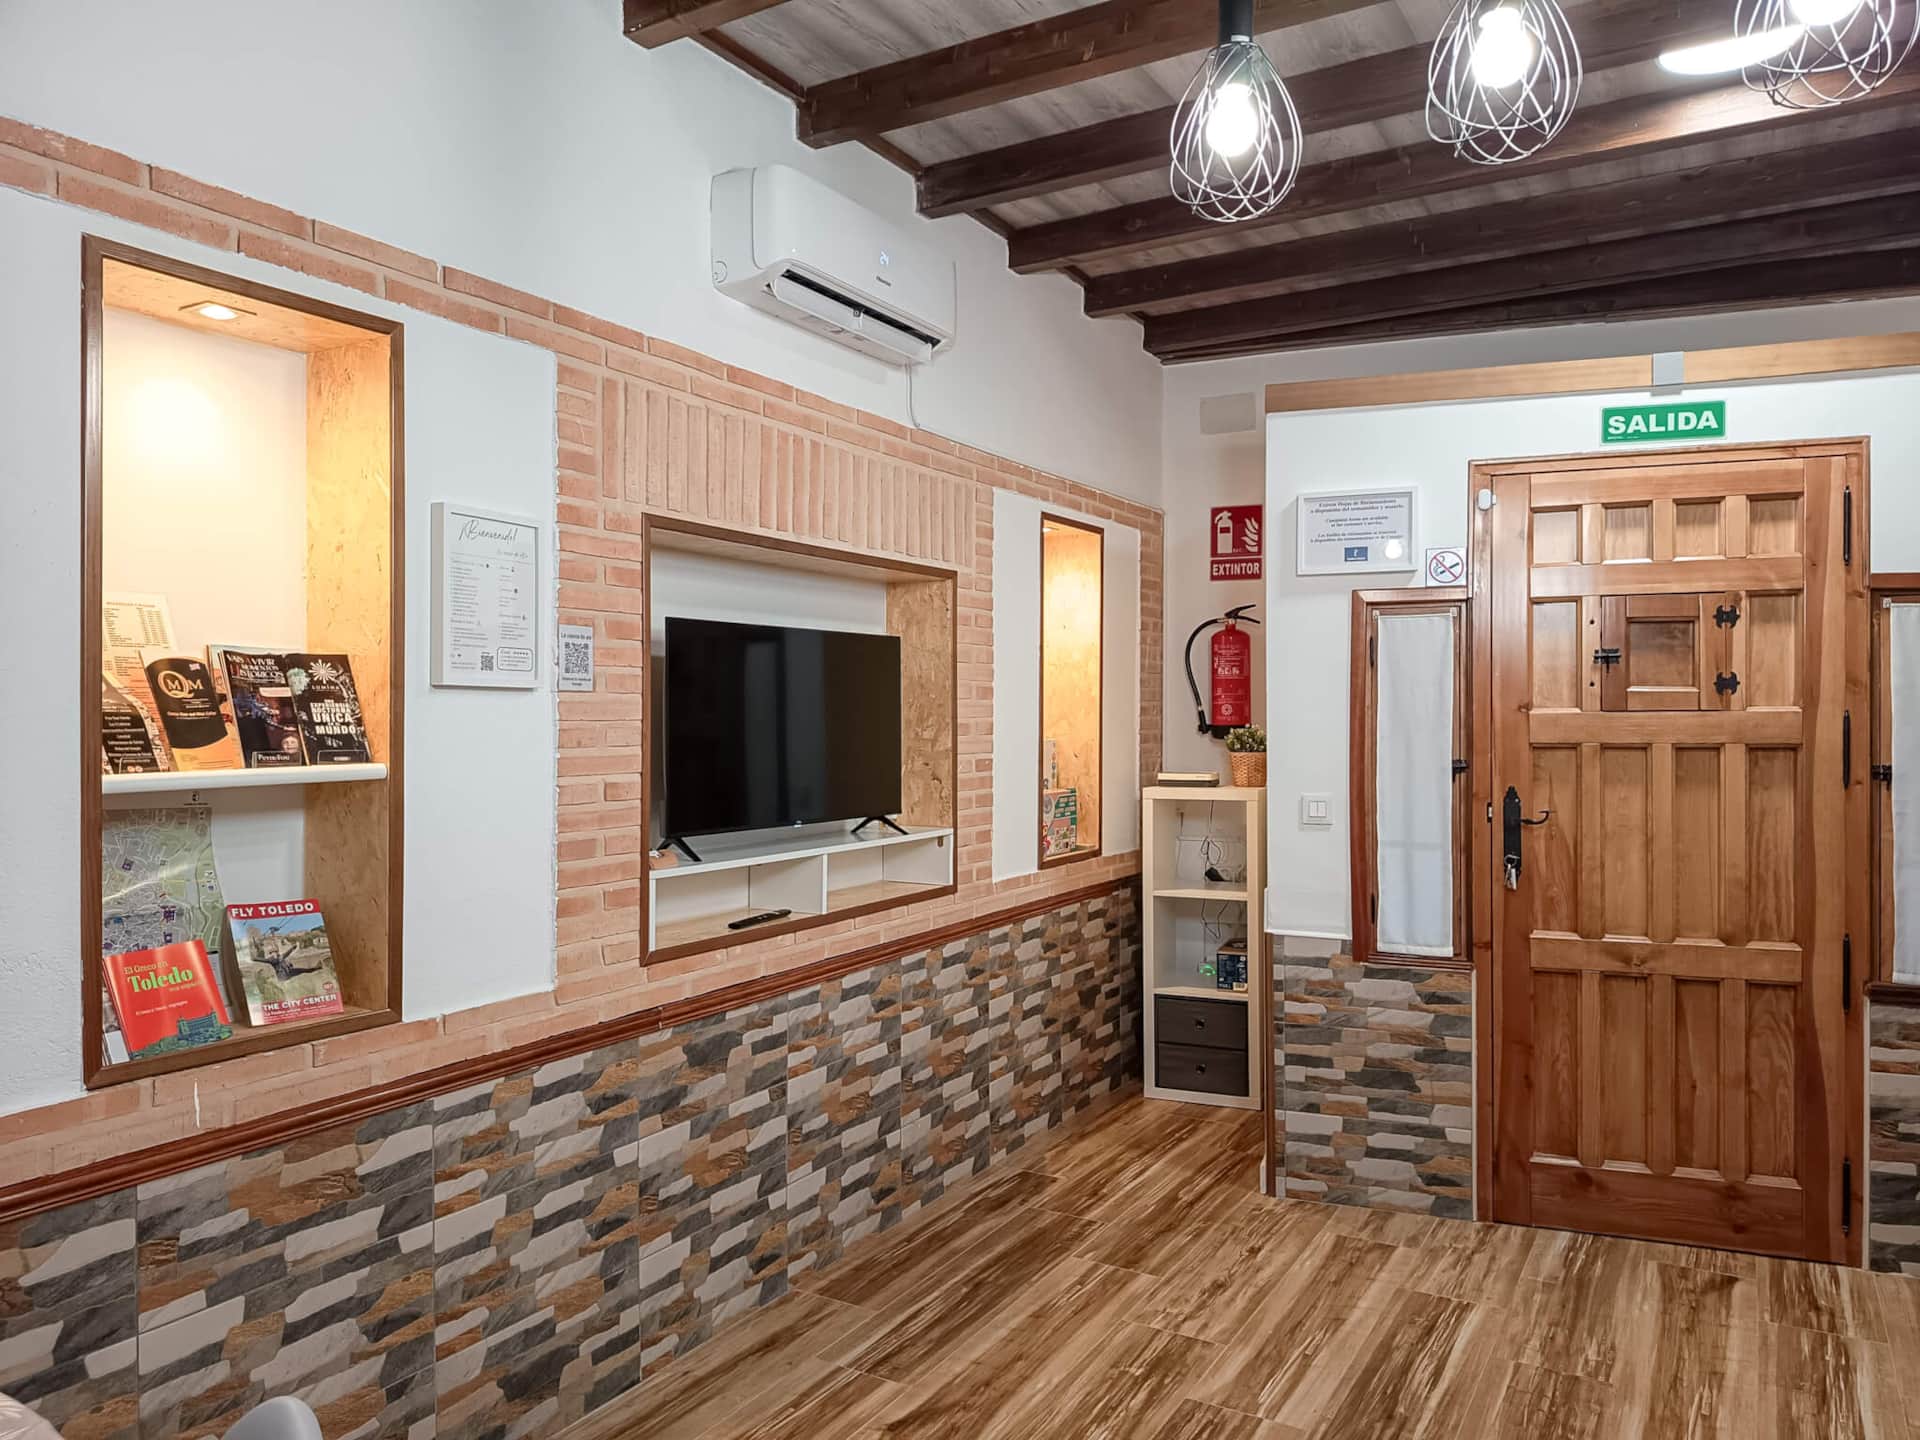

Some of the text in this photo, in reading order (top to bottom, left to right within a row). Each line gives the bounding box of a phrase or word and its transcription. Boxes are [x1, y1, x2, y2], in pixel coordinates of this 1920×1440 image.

[1607, 410, 1719, 435] SALIDA
[1212, 562, 1260, 576] EXTINTOR
[315, 725, 356, 735] MUNDO
[230, 902, 315, 918] FLY TOLEDO
[127, 966, 193, 993] Toledo
[262, 994, 337, 1011] THE CITY CENTER
